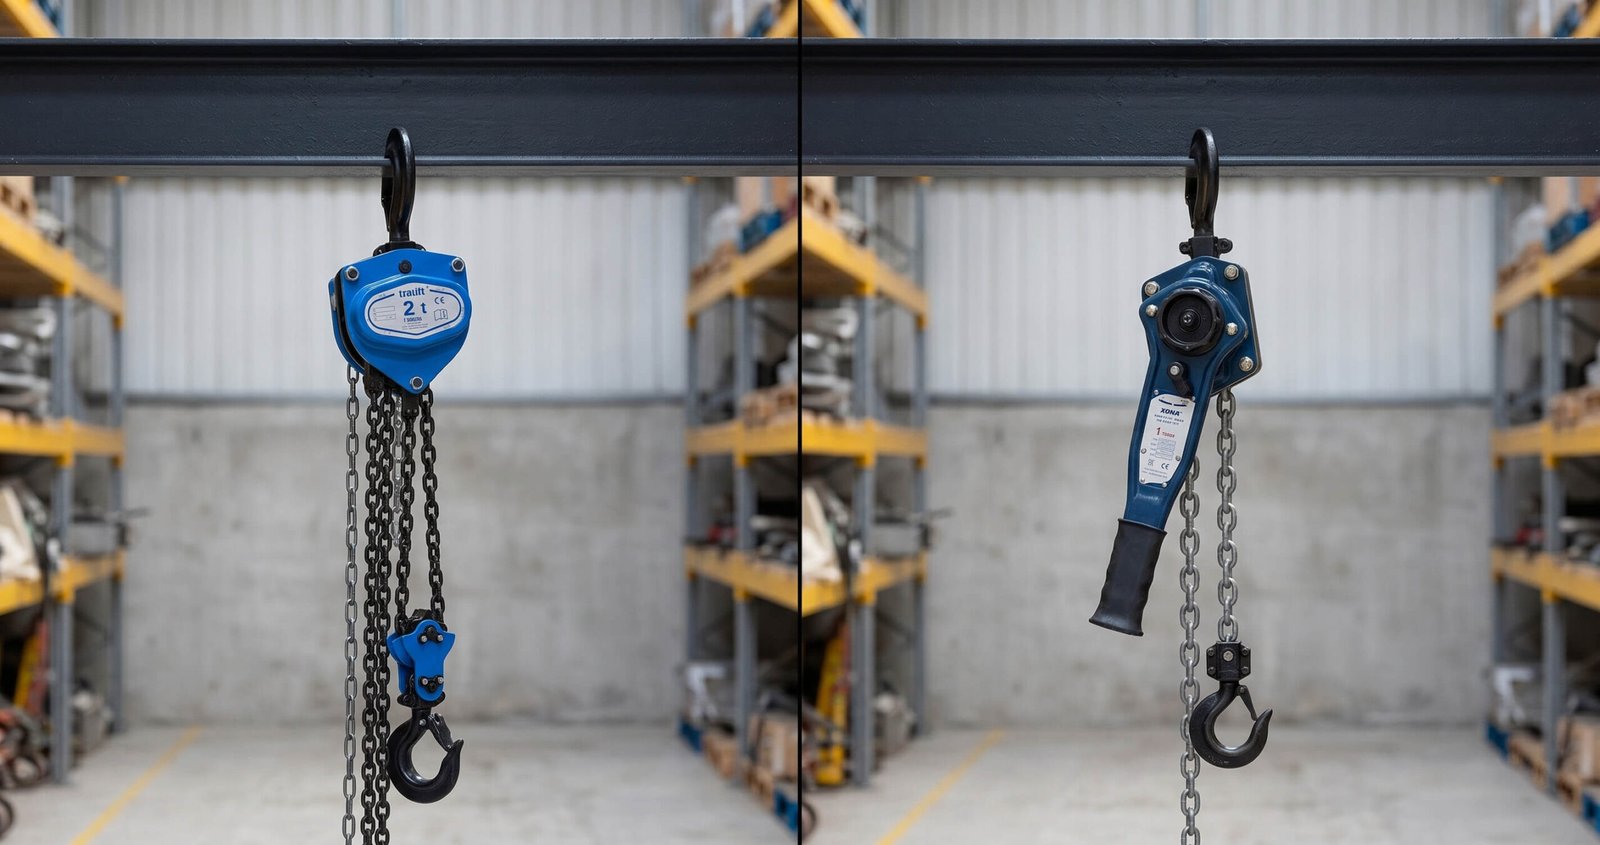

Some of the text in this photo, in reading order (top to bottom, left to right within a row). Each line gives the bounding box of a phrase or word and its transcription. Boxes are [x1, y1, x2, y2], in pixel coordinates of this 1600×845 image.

[403, 300, 415, 316] 2
[420, 302, 427, 314] t
[1160, 407, 1180, 416] XONA
[1156, 427, 1161, 436] 1
